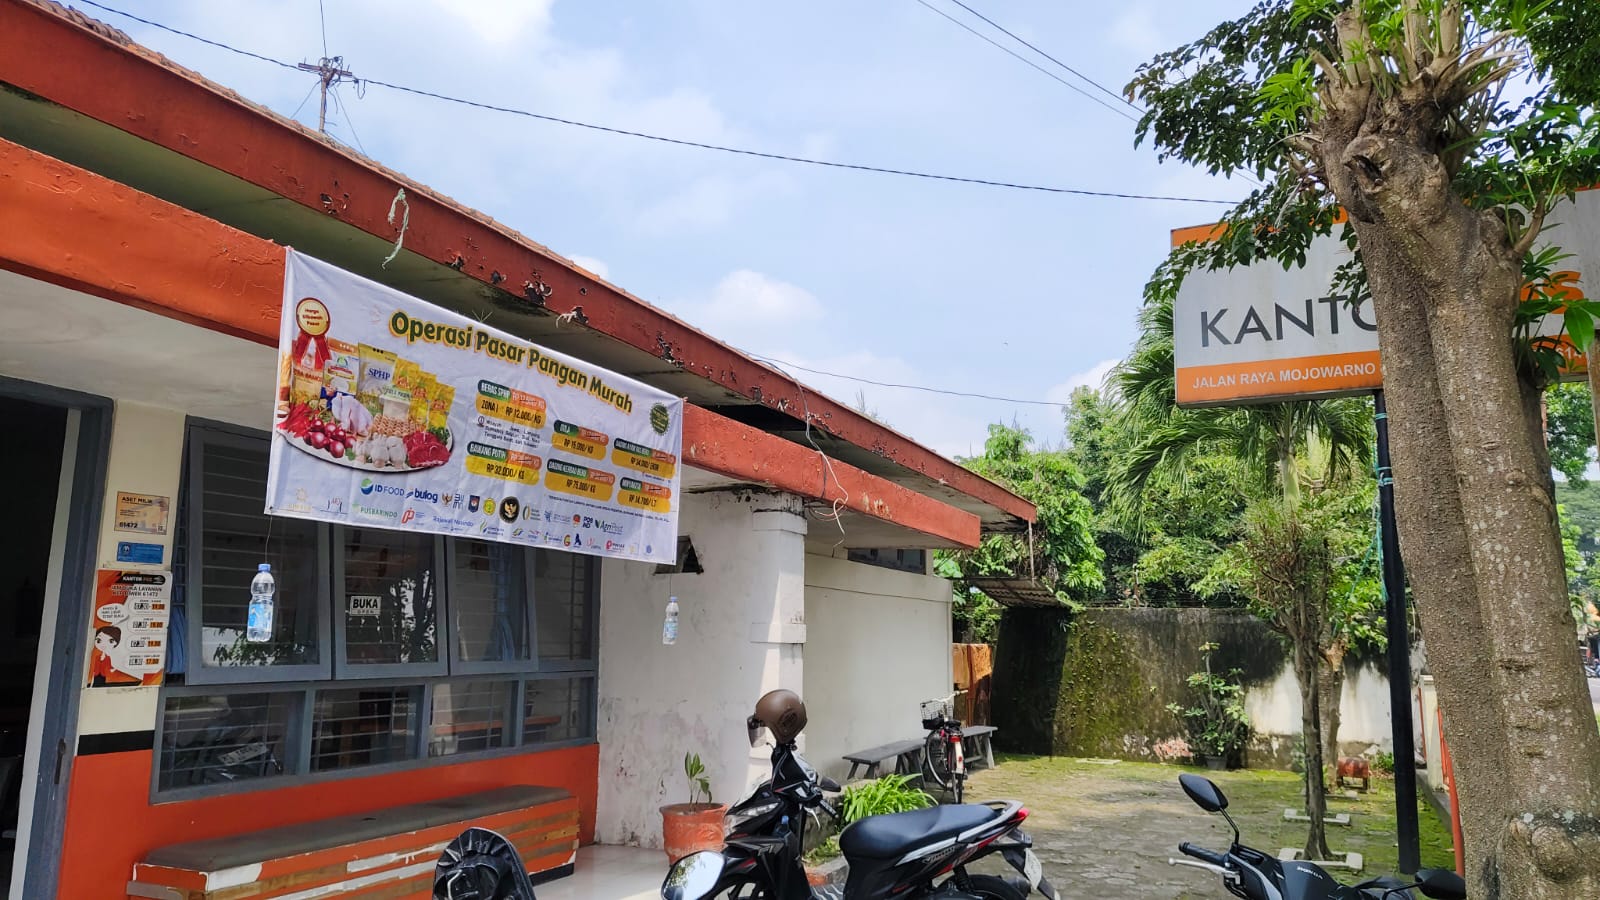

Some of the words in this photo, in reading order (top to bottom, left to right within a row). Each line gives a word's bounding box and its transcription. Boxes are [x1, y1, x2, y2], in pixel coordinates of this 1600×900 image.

[390, 311, 473, 348] Operasi
[475, 330, 525, 362] Pasar
[528, 348, 588, 388] Pangan
[589, 378, 633, 414] Murah
[367, 366, 391, 381] SPHP
[1192, 374, 1237, 390] JALAN
[1240, 371, 1276, 386] RAYA
[1279, 363, 1376, 382] MOJOWARNO
[481, 399, 496, 411] ZONA
[374, 484, 383, 493] ID
[383, 486, 405, 497] FOOD
[414, 487, 438, 504] bulog
[352, 598, 378, 609] BUKA
